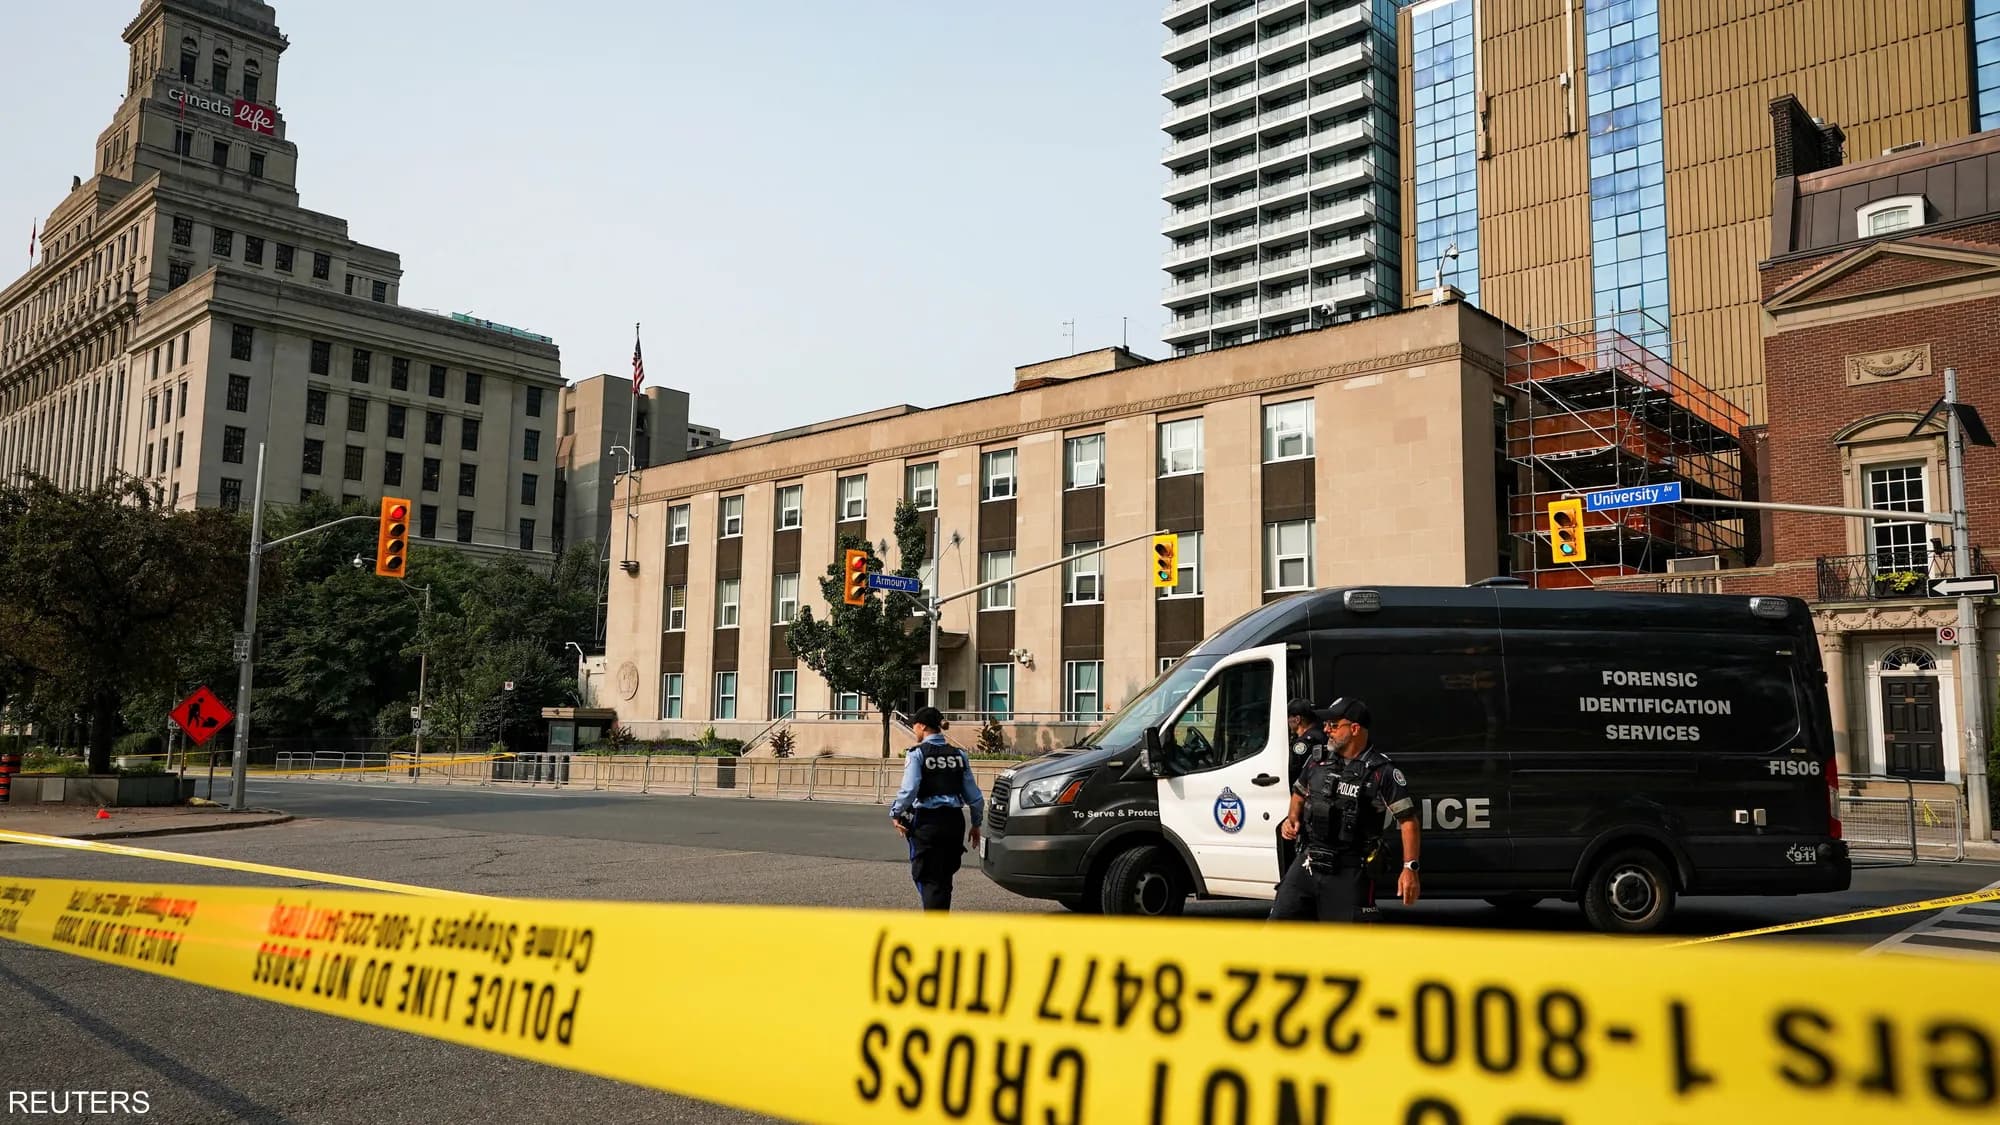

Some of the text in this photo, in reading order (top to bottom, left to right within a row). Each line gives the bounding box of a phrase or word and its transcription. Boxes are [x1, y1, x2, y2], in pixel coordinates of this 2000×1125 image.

[168, 88, 274, 131] canada life
[1593, 487, 1659, 507] University
[876, 576, 907, 590] Armoury
[1602, 671, 1698, 687] FORENSIC
[1579, 697, 1731, 715] IDENTIFICATION
[1606, 725, 1700, 741] SERVICES
[1769, 760, 1820, 776] FIS06
[1336, 782, 1360, 798] POLICE
[1088, 810, 1115, 818] Serve
[1128, 809, 1160, 817] Protec
[1383, 797, 1490, 830] ICE
[429, 911, 518, 965] Stoppers
[523, 925, 594, 974] Crime
[871, 929, 1014, 1016] (TIPS)
[253, 940, 581, 1046] POLICE LINE DO NOT CROSS
[1036, 953, 1717, 1097] 1-800-222-8477
[857, 1020, 1086, 1125] CROSS
